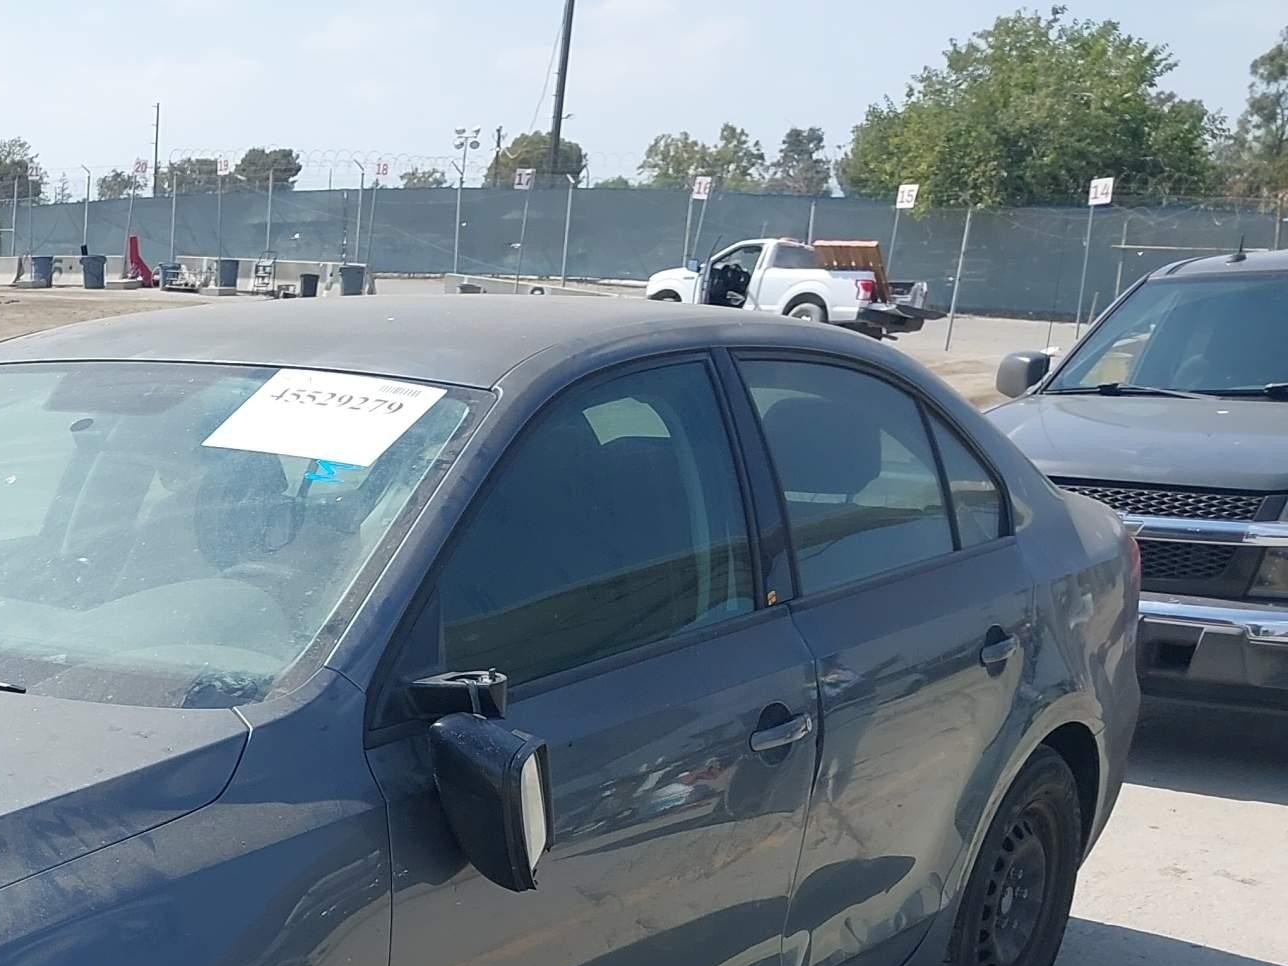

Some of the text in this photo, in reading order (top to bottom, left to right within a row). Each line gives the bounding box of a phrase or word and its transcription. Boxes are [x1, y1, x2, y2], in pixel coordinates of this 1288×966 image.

[29, 166, 39, 177] 21
[135, 161, 147, 173] 20
[219, 160, 229, 171] 19
[376, 163, 388, 176] 18
[516, 173, 531, 186] 17
[898, 189, 914, 204] 15
[1091, 183, 1109, 200] 14
[270, 388, 404, 414] 45529279
